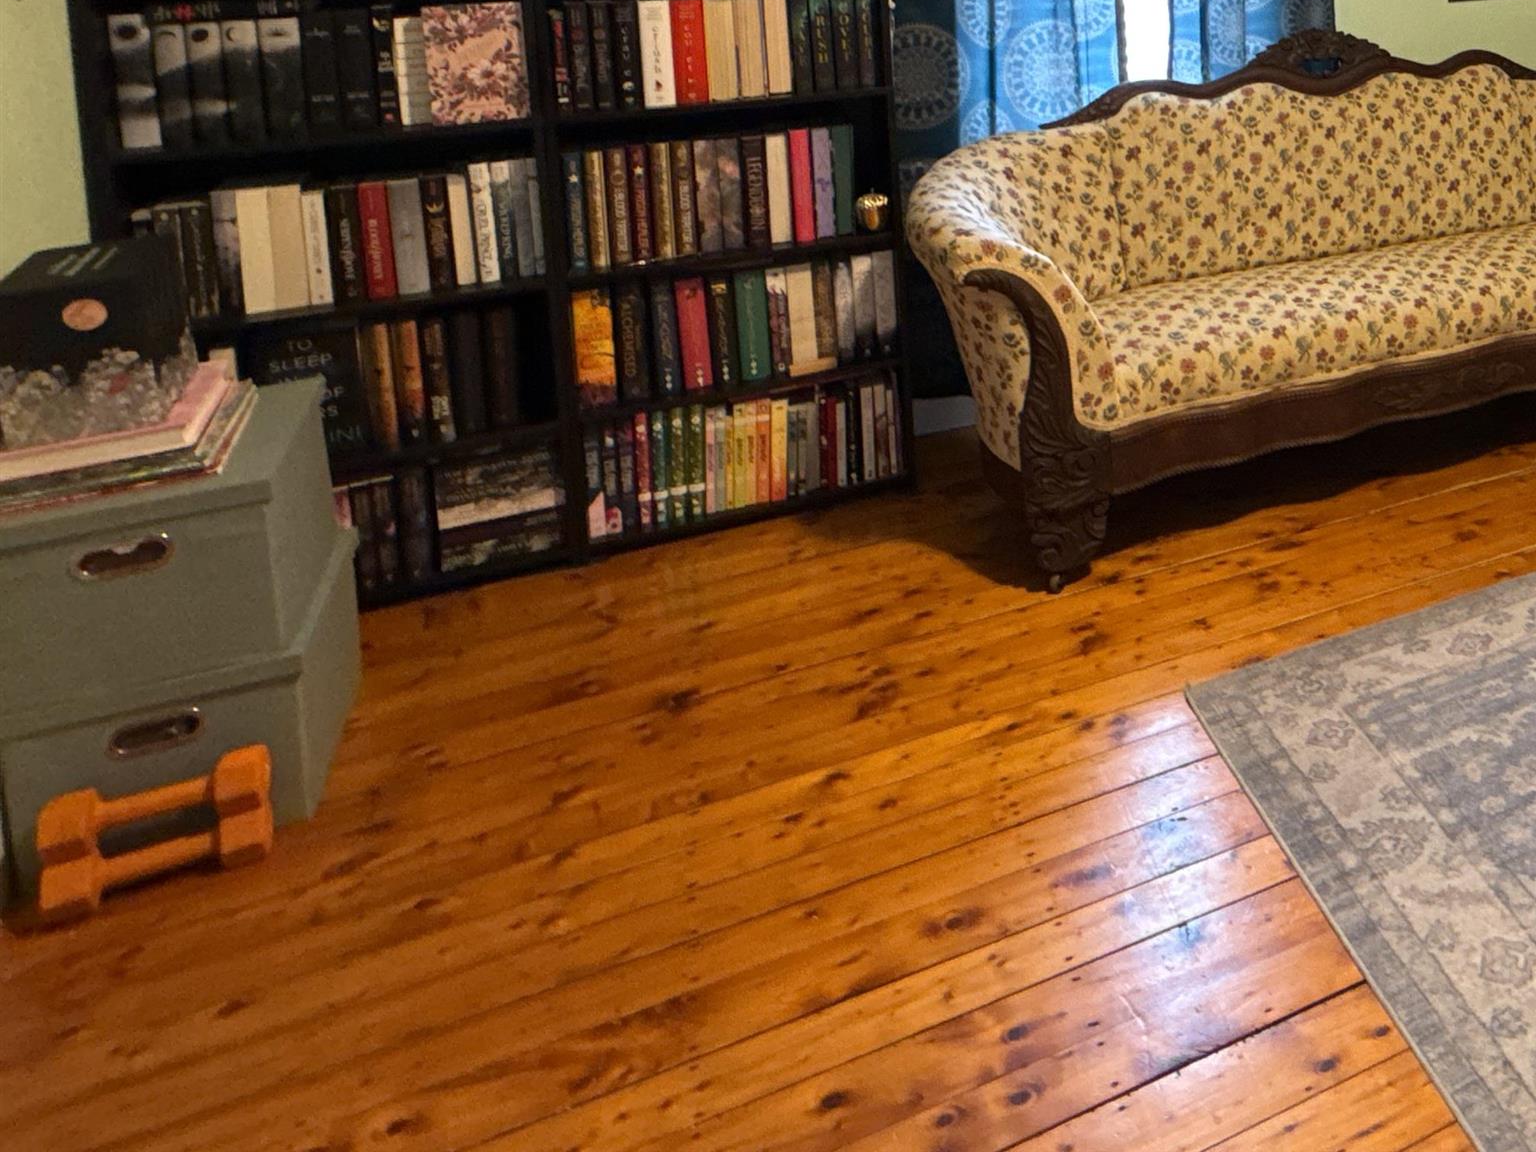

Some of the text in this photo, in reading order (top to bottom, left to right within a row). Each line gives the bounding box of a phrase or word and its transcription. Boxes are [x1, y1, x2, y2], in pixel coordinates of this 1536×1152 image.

[289, 338, 312, 352] TO
[620, 302, 637, 377] ALCHEMISED
[269, 352, 333, 374] SLEEP
